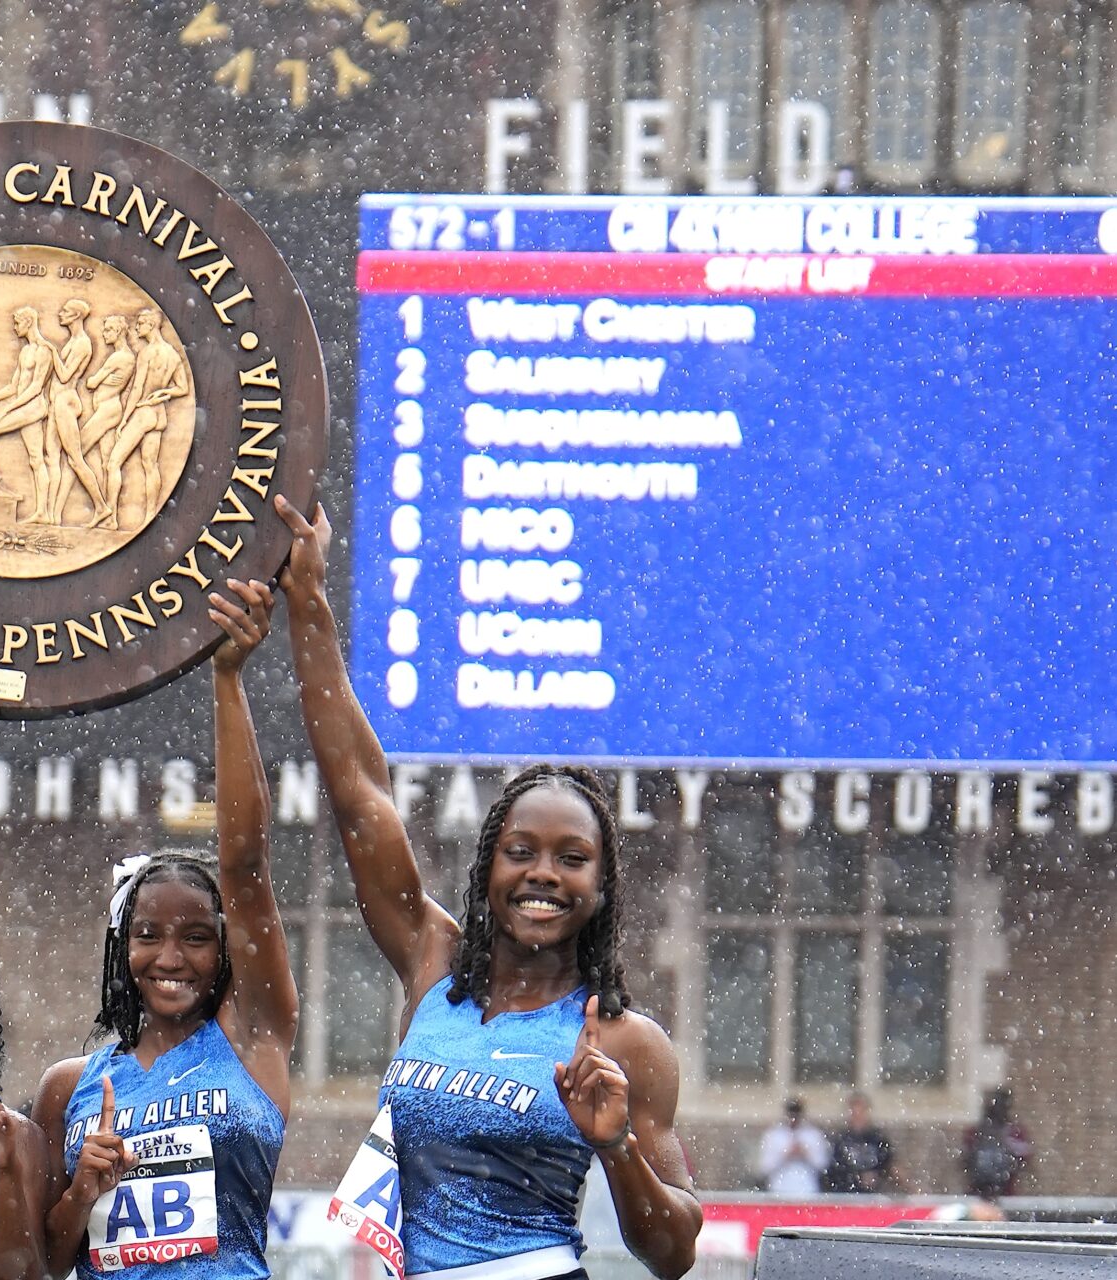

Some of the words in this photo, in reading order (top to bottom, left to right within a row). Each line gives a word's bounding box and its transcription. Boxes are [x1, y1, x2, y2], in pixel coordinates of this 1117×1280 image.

[486, 100, 833, 193] FIELD
[4, 161, 254, 326] CARNIVAL
[806, 204, 979, 255] COLLEGE
[58, 265, 96, 281] 1895
[399, 295, 423, 340] 1
[395, 347, 426, 394] 2
[394, 400, 424, 447] 3
[0, 356, 282, 665] PENNSYLVANIA
[390, 504, 422, 551] 6
[390, 557, 421, 601] 7
[387, 608, 419, 655] 8
[386, 660, 418, 708] 9
[391, 763, 712, 838] FALY
[142, 1089, 229, 1126] ALLEN
[444, 1069, 539, 1114] ALLEN
[133, 1132, 176, 1153] PENN
[137, 1166, 156, 1178] On.
[106, 1180, 195, 1244] AB
[124, 1242, 203, 1263] TOYOTA
